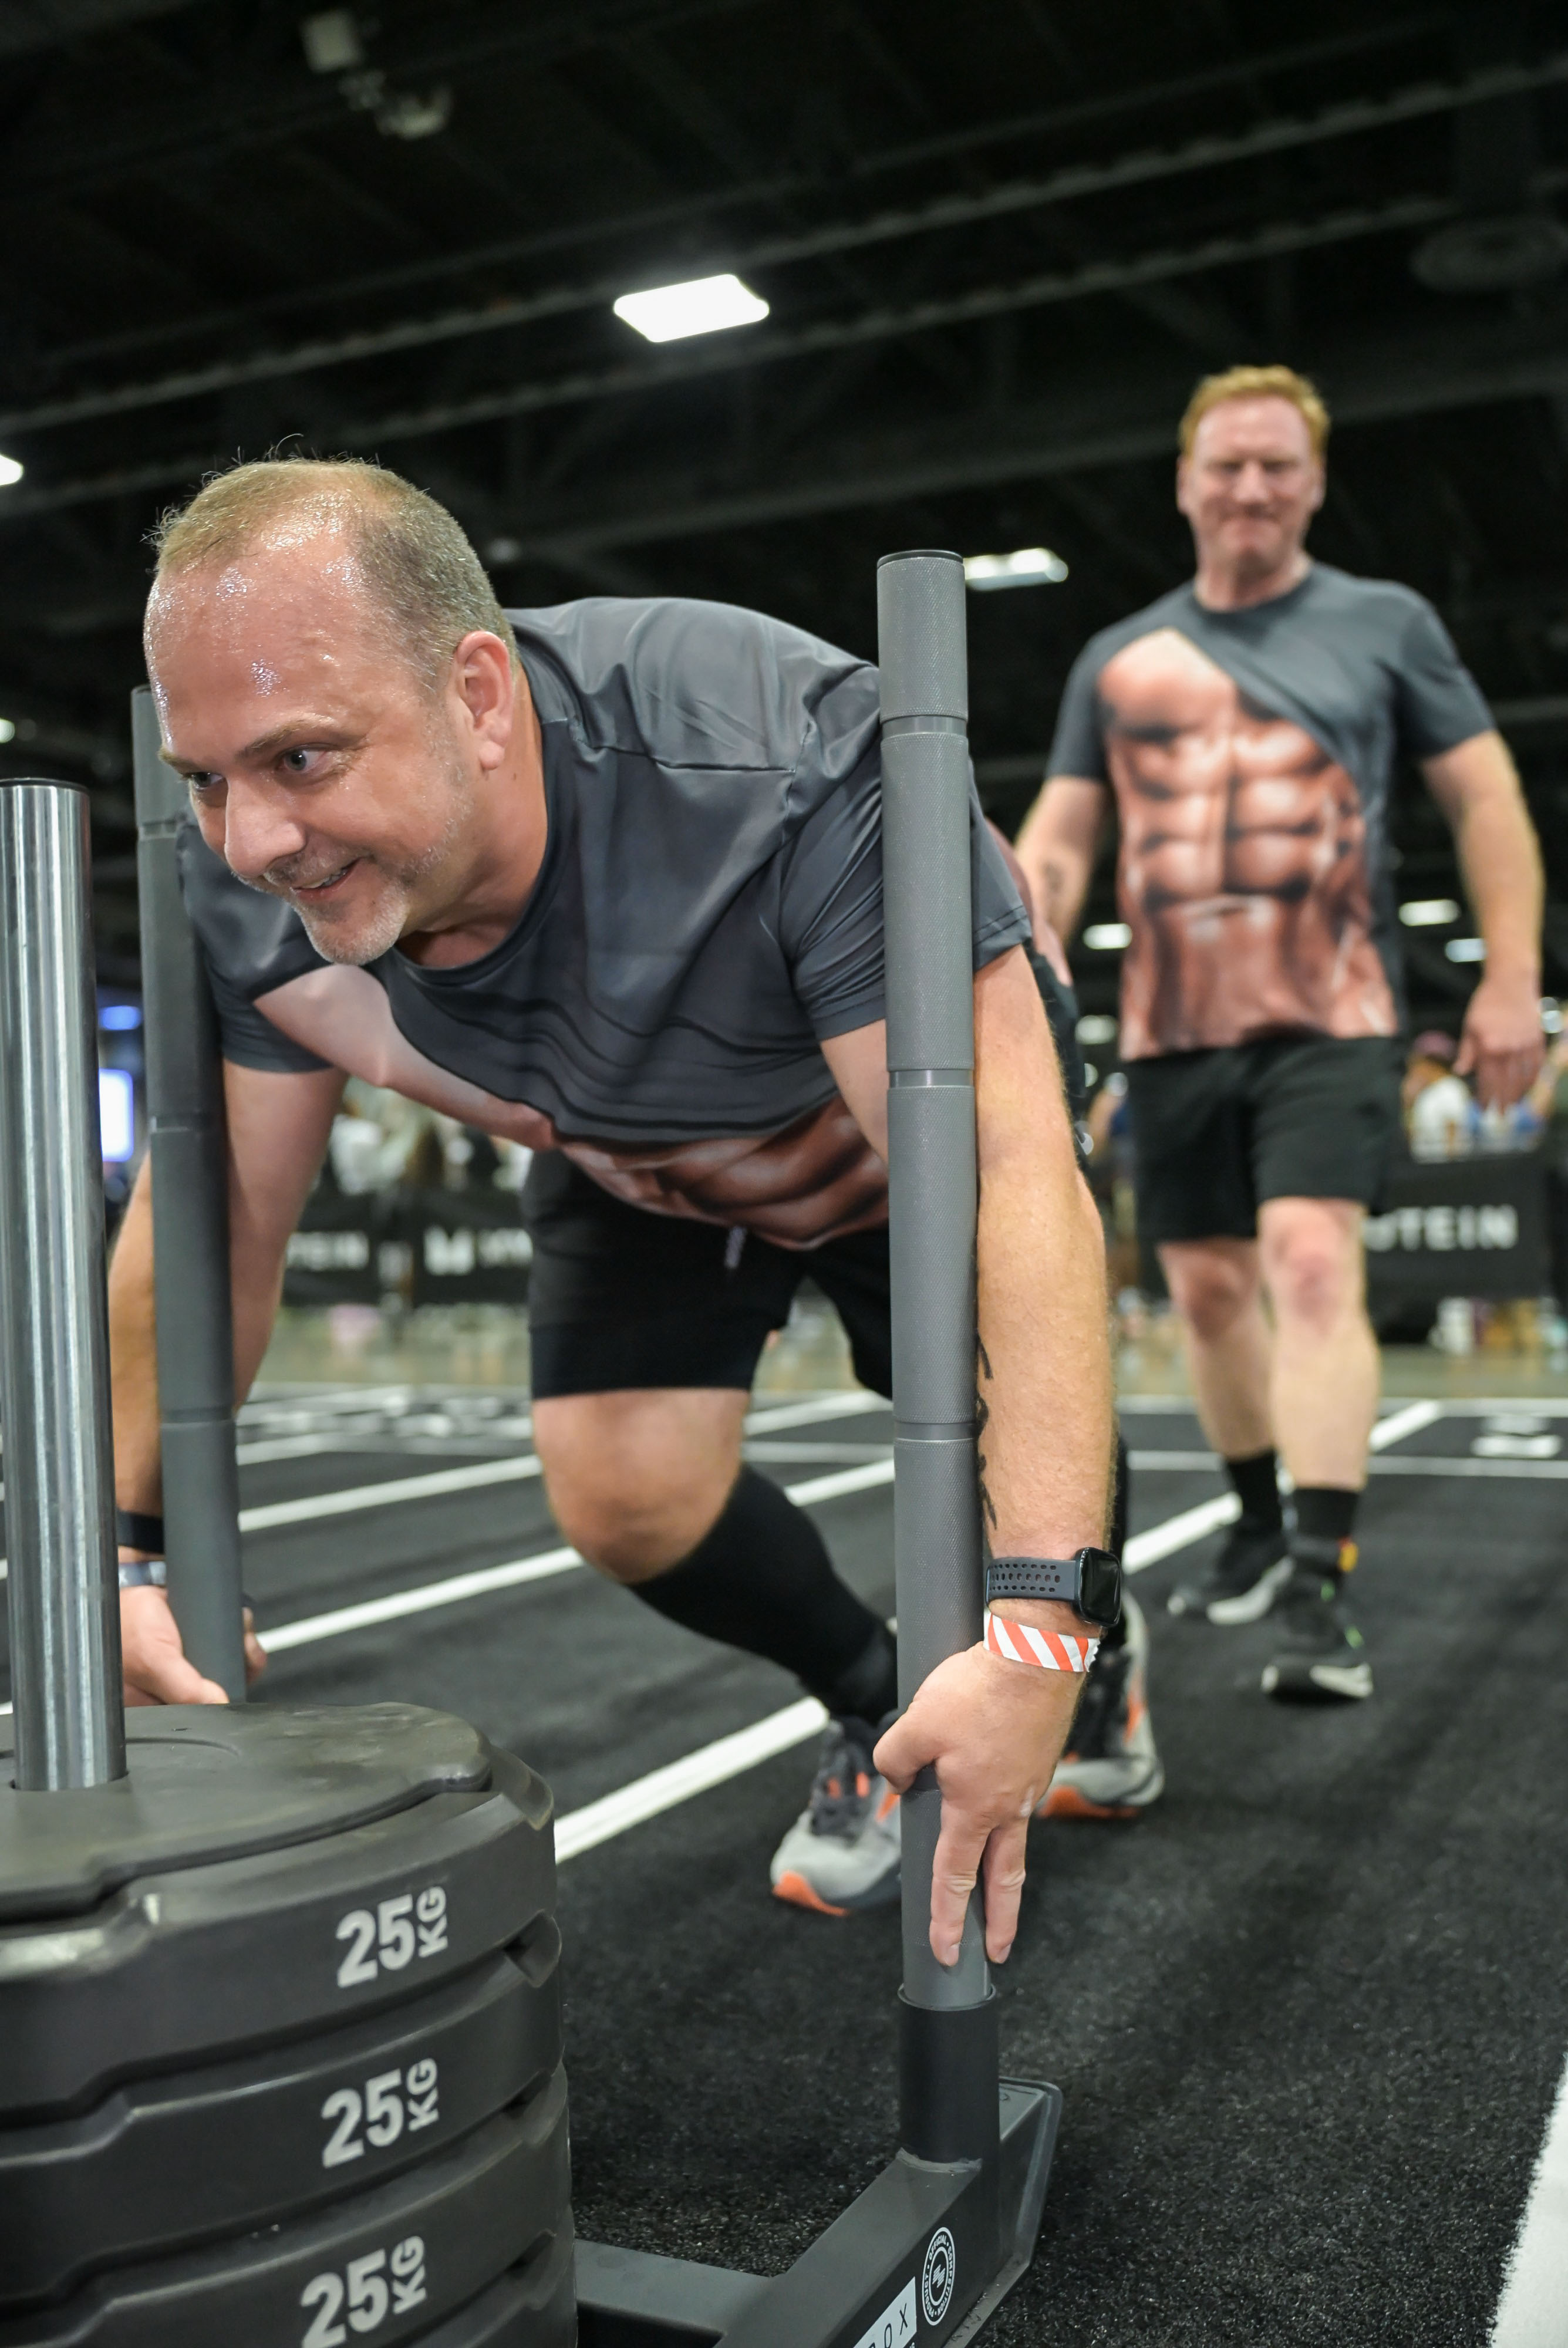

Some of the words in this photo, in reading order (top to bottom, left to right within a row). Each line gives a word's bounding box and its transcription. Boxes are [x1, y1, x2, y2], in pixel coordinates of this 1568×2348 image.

[336, 1894, 415, 1988] 25
[416, 1885, 448, 1957] KG
[321, 2069, 404, 2169] 25
[406, 2057, 440, 2131] KG
[929, 2234, 946, 2260] OFFICIAL
[938, 2245, 953, 2316] COMPETITION
[300, 2249, 389, 2348] 25
[390, 2235, 427, 2315] KG
[924, 2274, 935, 2319] PRODUCT
